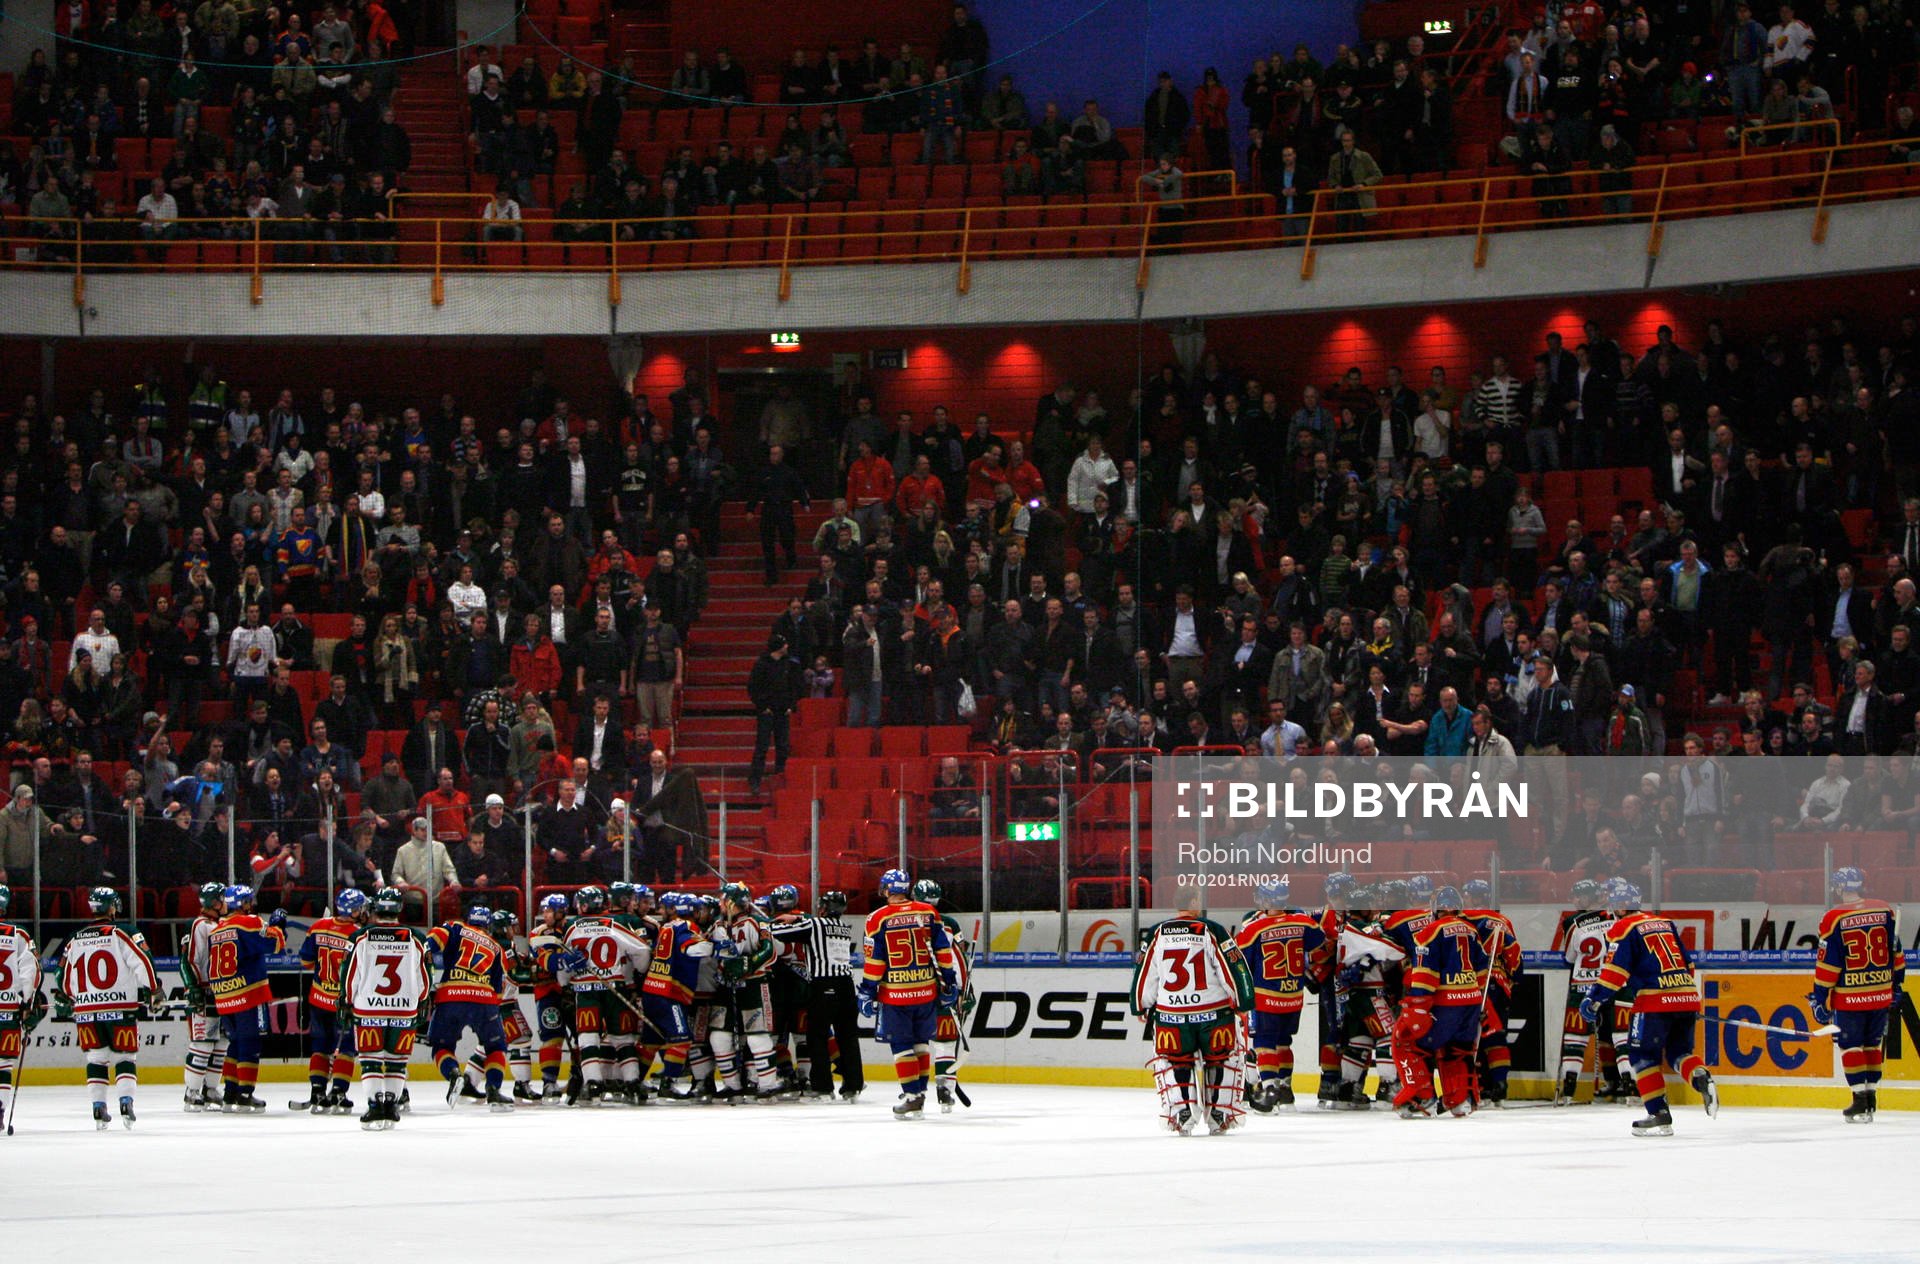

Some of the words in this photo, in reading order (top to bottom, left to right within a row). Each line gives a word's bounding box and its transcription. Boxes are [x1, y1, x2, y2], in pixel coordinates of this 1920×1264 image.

[370, 934, 395, 942] KUMHO
[1842, 914, 1886, 927] BAUHAUS
[209, 941, 238, 980] 18
[455, 937, 495, 976] 17
[885, 927, 932, 968] 55
[1261, 938, 1305, 981] 26
[1456, 935, 1474, 972] 1
[1643, 932, 1688, 973] 15
[1841, 926, 1889, 971] 38
[73, 949, 119, 993] 10
[374, 955, 404, 996] 3
[1162, 948, 1208, 992] 31
[1280, 979, 1299, 992] ASK
[1845, 970, 1893, 986] ERICSSON
[76, 991, 127, 1004] HANSSON
[367, 997, 410, 1007] VALLIN
[447, 989, 493, 998] SVANSTRÖMS
[1168, 993, 1201, 1005] SALO
[1704, 981, 1809, 1070] ice
